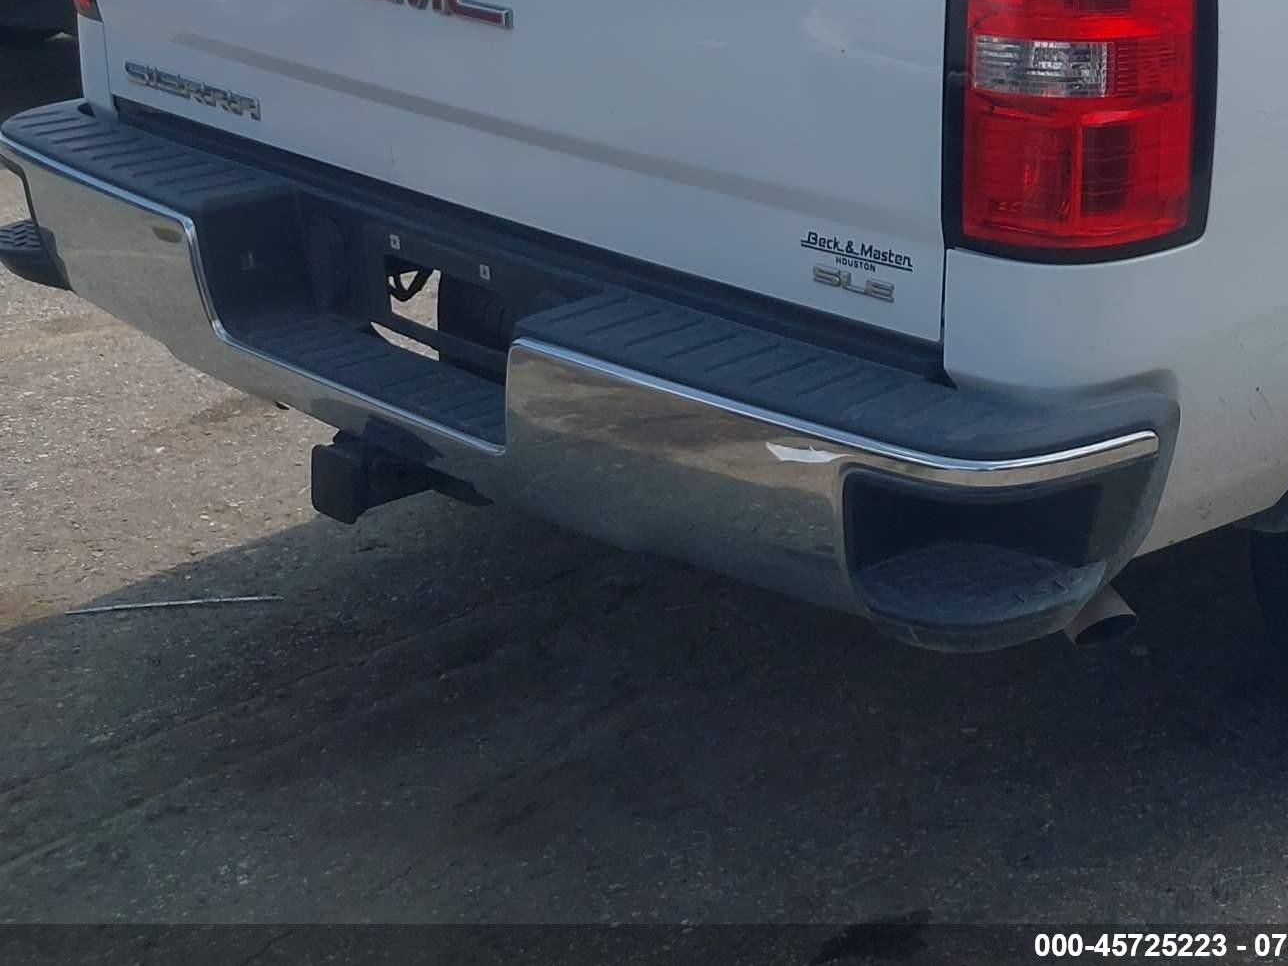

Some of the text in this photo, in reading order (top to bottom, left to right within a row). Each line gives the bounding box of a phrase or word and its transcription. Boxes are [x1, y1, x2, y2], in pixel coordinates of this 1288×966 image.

[124, 60, 262, 122] SIERRA
[804, 231, 844, 253] Beck
[845, 240, 860, 255] &
[835, 256, 876, 273] HOUSTON
[812, 263, 895, 304] SLE
